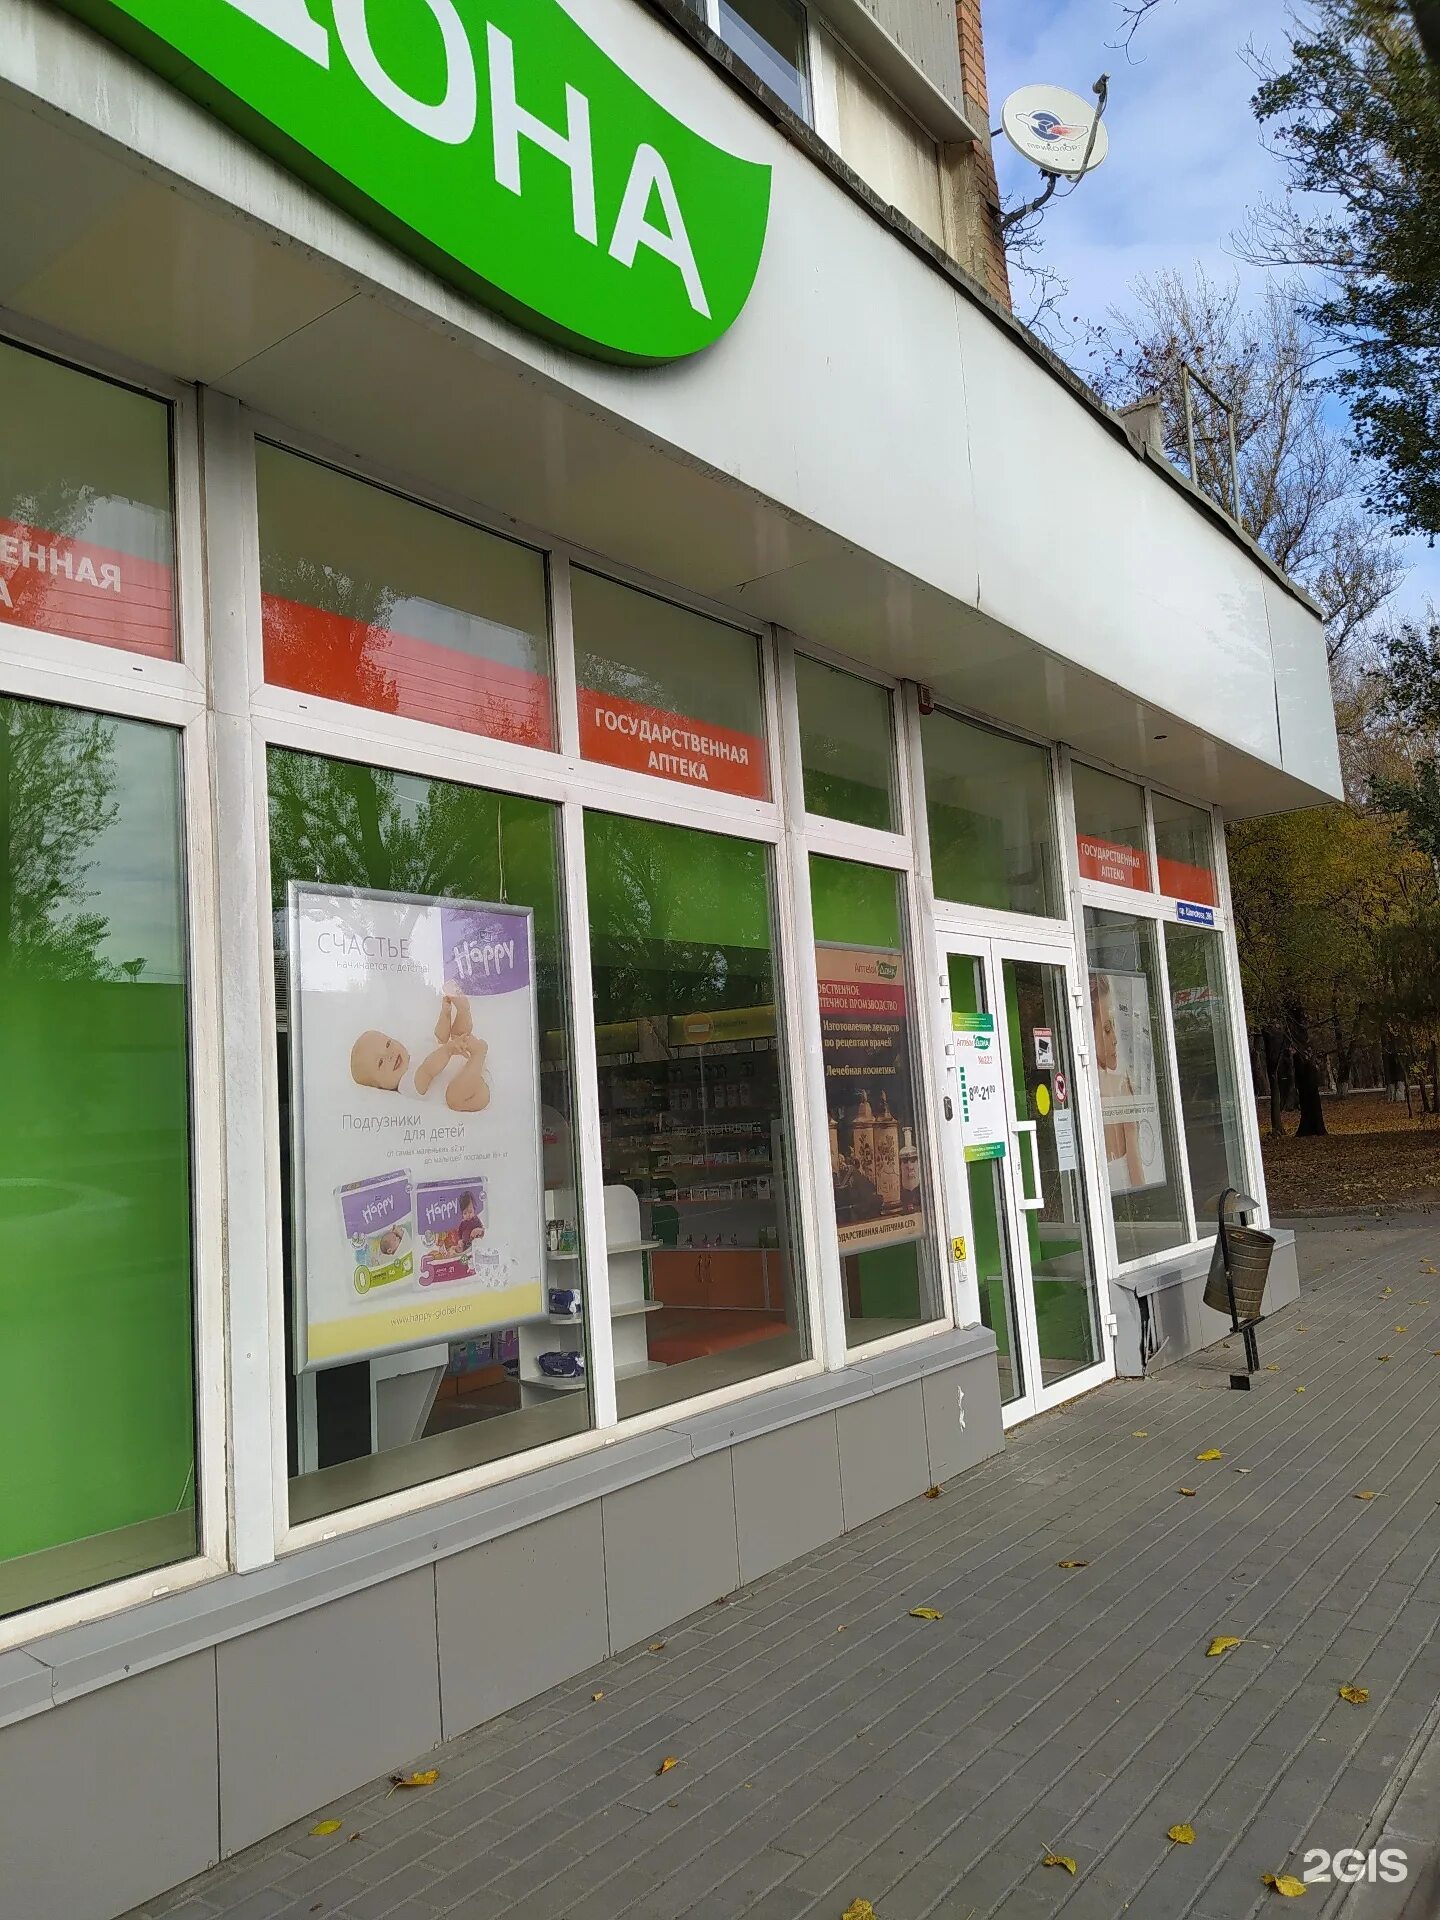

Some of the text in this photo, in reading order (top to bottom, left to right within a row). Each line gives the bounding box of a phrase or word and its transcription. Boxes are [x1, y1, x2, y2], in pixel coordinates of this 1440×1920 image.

[0, 534, 121, 593] ЕННАЯ
[595, 708, 749, 765] ГОСУДАРСТВЕННАЯ
[648, 750, 708, 781] АПТЕКА
[1081, 843, 1140, 868] ГОСУДАРСТВЕННАЯ
[1101, 865, 1125, 881] АПТЕКА
[317, 932, 410, 959] СЧАСТЬЕ
[336, 960, 388, 971] начинается
[850, 999, 898, 1011] ПРОИЗВОДСТВО
[823, 1020, 900, 1035] Изготовление лекарств
[825, 1037, 892, 1049] по рецептам врачей
[826, 1065, 896, 1077] Лечебная косметика
[342, 1114, 421, 1132] Подгузники
[404, 1122, 465, 1143] для детей
[880, 1221, 904, 1234] АПТЕЧНАЯ
[905, 1219, 915, 1229] СЕТЬ
